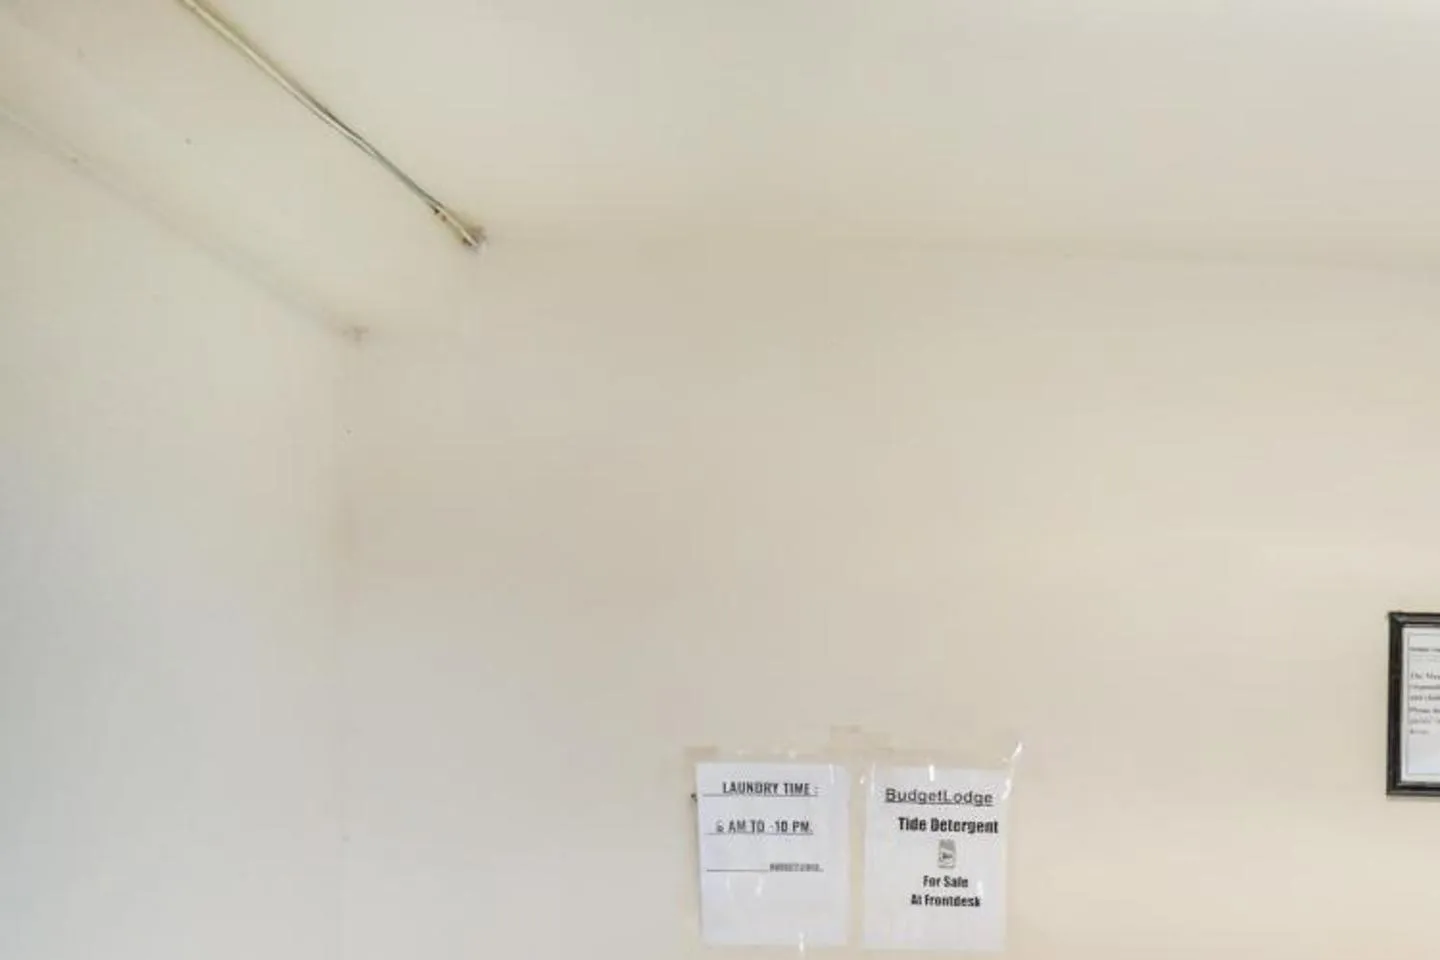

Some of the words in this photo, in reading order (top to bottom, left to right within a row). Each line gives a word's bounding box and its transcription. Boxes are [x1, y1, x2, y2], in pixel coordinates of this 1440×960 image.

[722, 781, 779, 796] LAUNDRY
[885, 787, 994, 806] BudgetLodge
[727, 819, 747, 833] AM
[751, 819, 766, 833] TO
[898, 816, 927, 831] Tide
[930, 817, 998, 834] Detergent
[923, 874, 941, 888] For
[943, 874, 969, 888] Sale
[925, 894, 981, 907] Frontdesk
